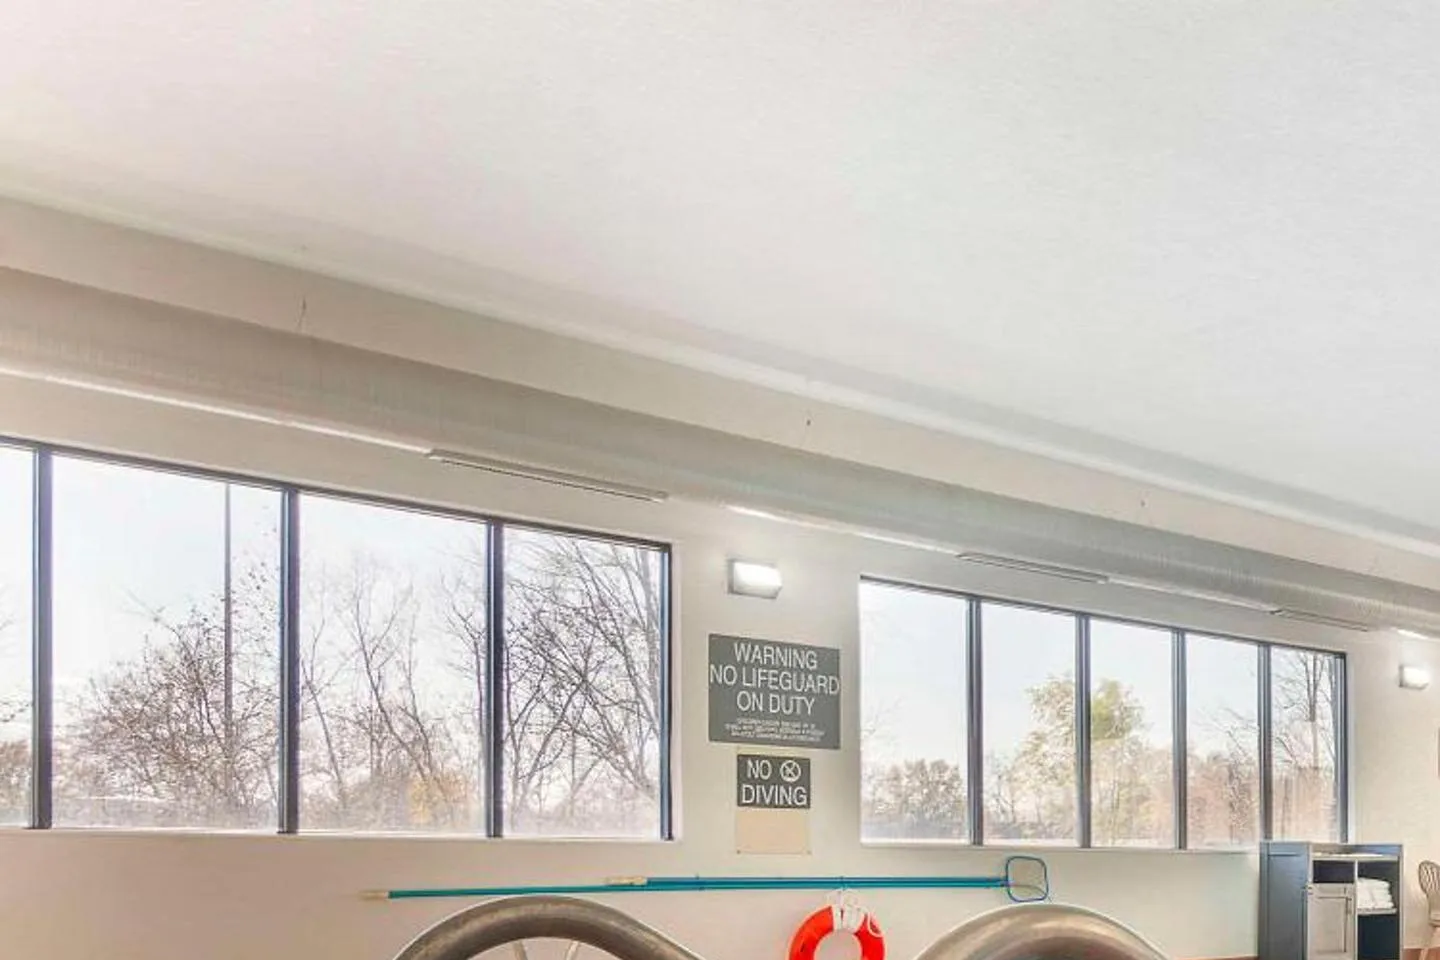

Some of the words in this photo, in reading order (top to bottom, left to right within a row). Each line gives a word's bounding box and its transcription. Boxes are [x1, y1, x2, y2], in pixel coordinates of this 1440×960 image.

[734, 643, 818, 670] WARNING
[710, 664, 737, 686] NO
[742, 668, 840, 695] LIFEGUARD
[736, 690, 763, 711] ON
[769, 694, 815, 715] DUTY
[747, 760, 772, 779] NO
[741, 784, 808, 806] DIVING
